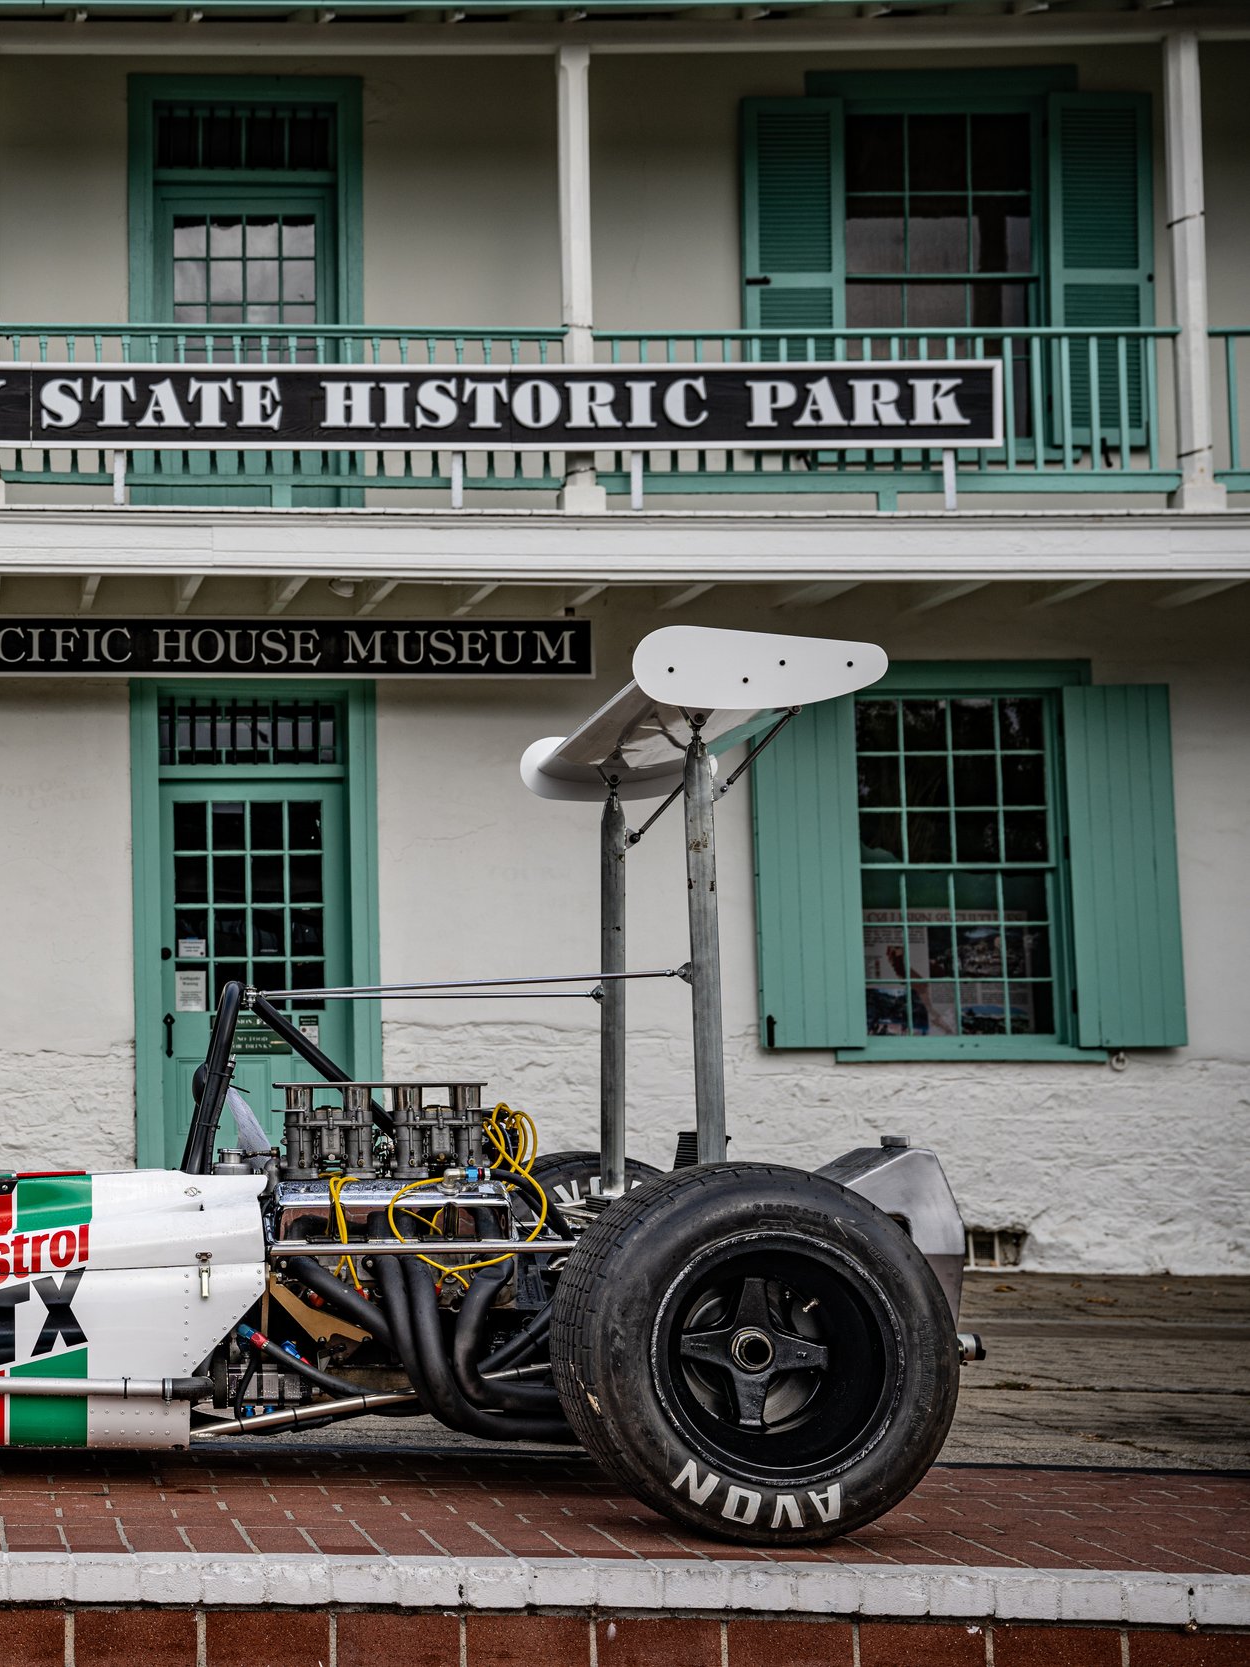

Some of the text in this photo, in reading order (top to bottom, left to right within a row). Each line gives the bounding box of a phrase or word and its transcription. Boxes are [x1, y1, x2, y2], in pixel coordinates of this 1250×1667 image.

[40, 376, 283, 430] STATE
[320, 376, 708, 429] HISTORIC
[745, 377, 971, 427] PARK
[152, 629, 322, 666] HOUSE
[343, 630, 577, 666] MUSEUM
[866, 911, 932, 923] COLLIION
[671, 1458, 842, 1529] AVON
